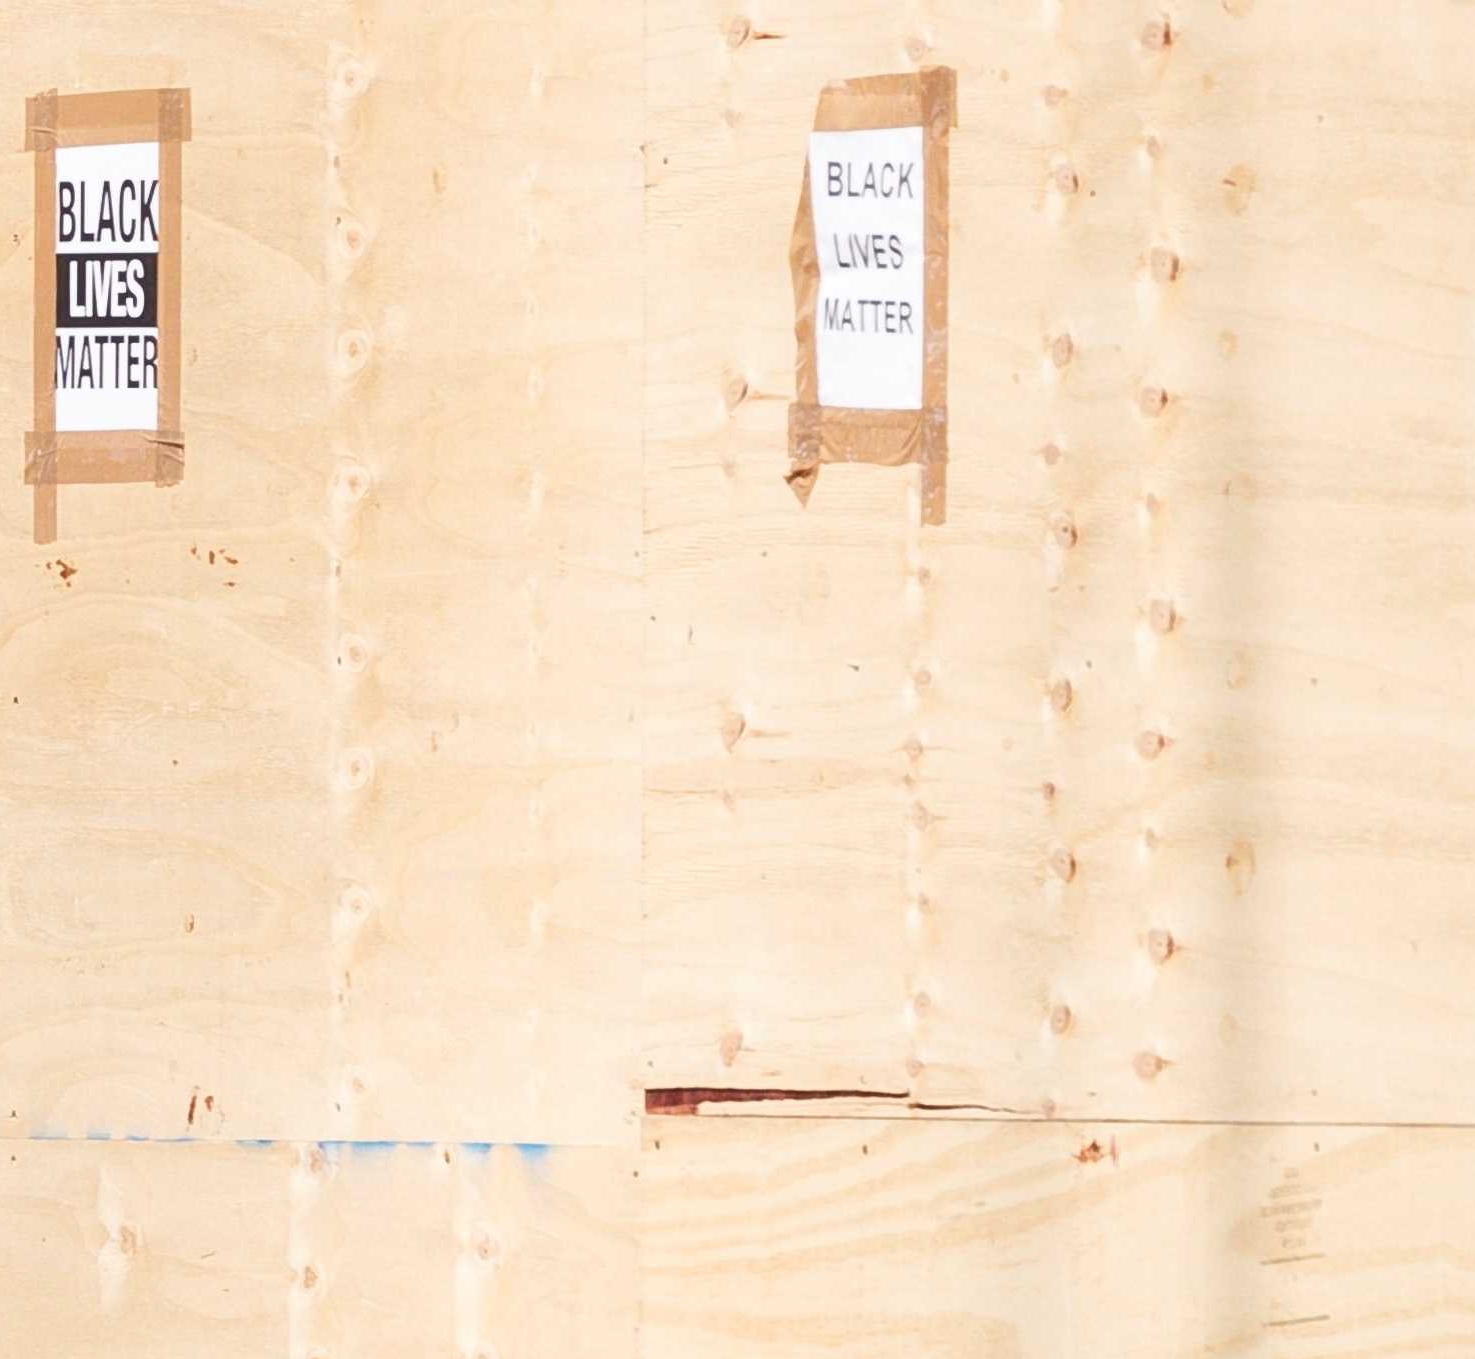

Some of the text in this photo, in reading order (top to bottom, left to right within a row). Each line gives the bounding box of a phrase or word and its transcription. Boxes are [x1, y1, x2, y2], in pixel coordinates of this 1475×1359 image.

[827, 161, 913, 198] BLACK
[58, 180, 159, 243] BLACK
[833, 234, 904, 270] LIVES
[68, 258, 145, 319] LIVES
[824, 299, 914, 335] MATTER
[54, 335, 158, 390] MATTER
